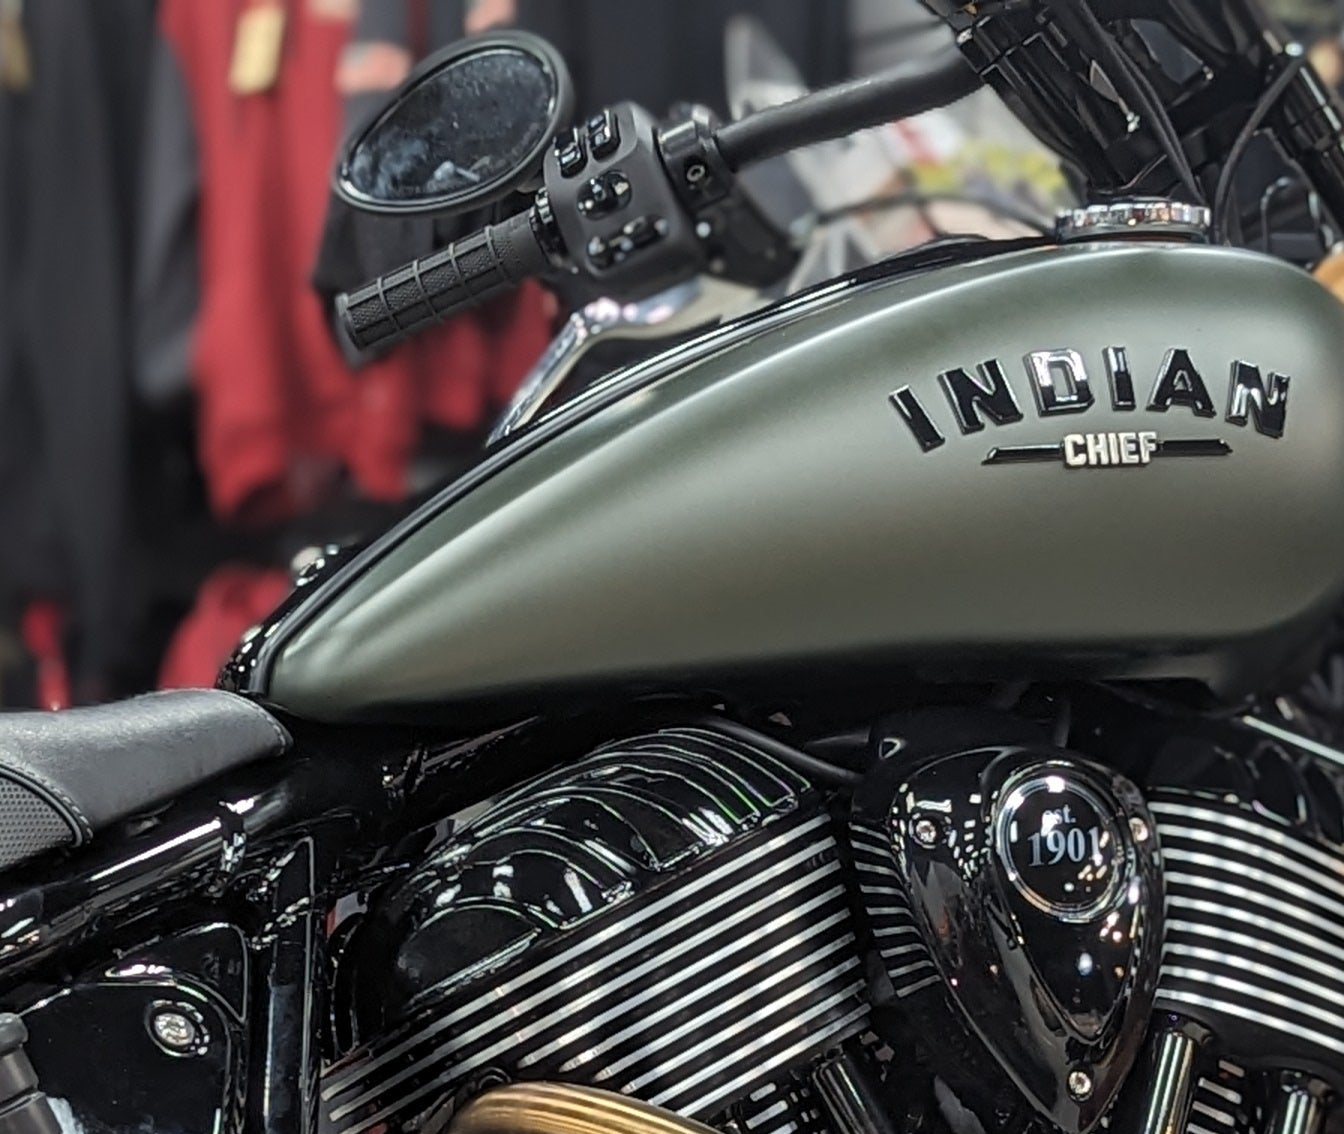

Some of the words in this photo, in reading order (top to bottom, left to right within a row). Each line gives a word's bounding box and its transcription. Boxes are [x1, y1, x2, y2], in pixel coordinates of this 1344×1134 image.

[889, 346, 1291, 452] INDIAN
[1064, 432, 1157, 466] CHIEF
[1027, 827, 1102, 867] 1901
